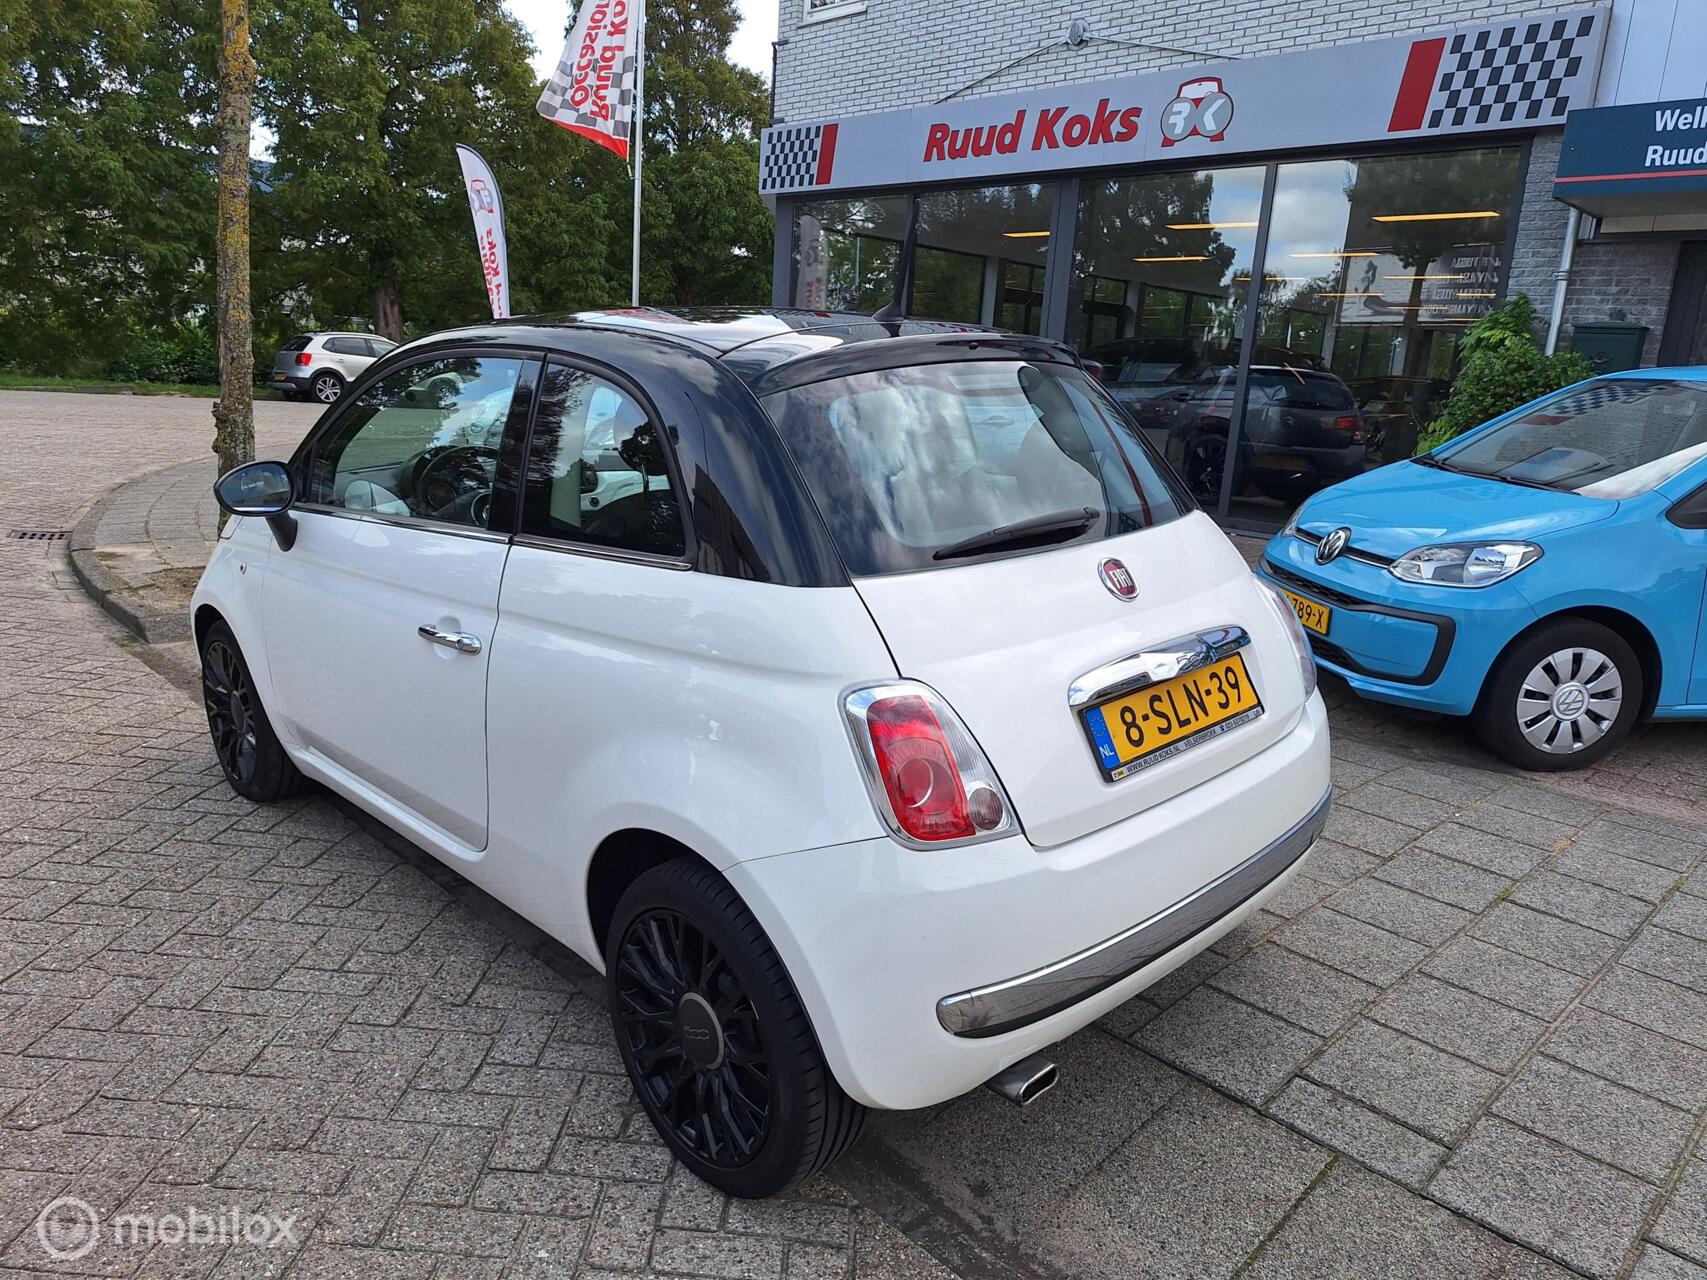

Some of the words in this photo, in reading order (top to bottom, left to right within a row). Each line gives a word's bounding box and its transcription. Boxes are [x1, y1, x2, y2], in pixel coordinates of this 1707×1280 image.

[923, 110, 1028, 163] Ruud
[1031, 98, 1143, 151] Koks
[1644, 141, 1707, 167] Ruud
[1108, 567, 1134, 590] FIAT
[1119, 665, 1241, 748] 8-SLN-39
[1100, 743, 1115, 757] NL
